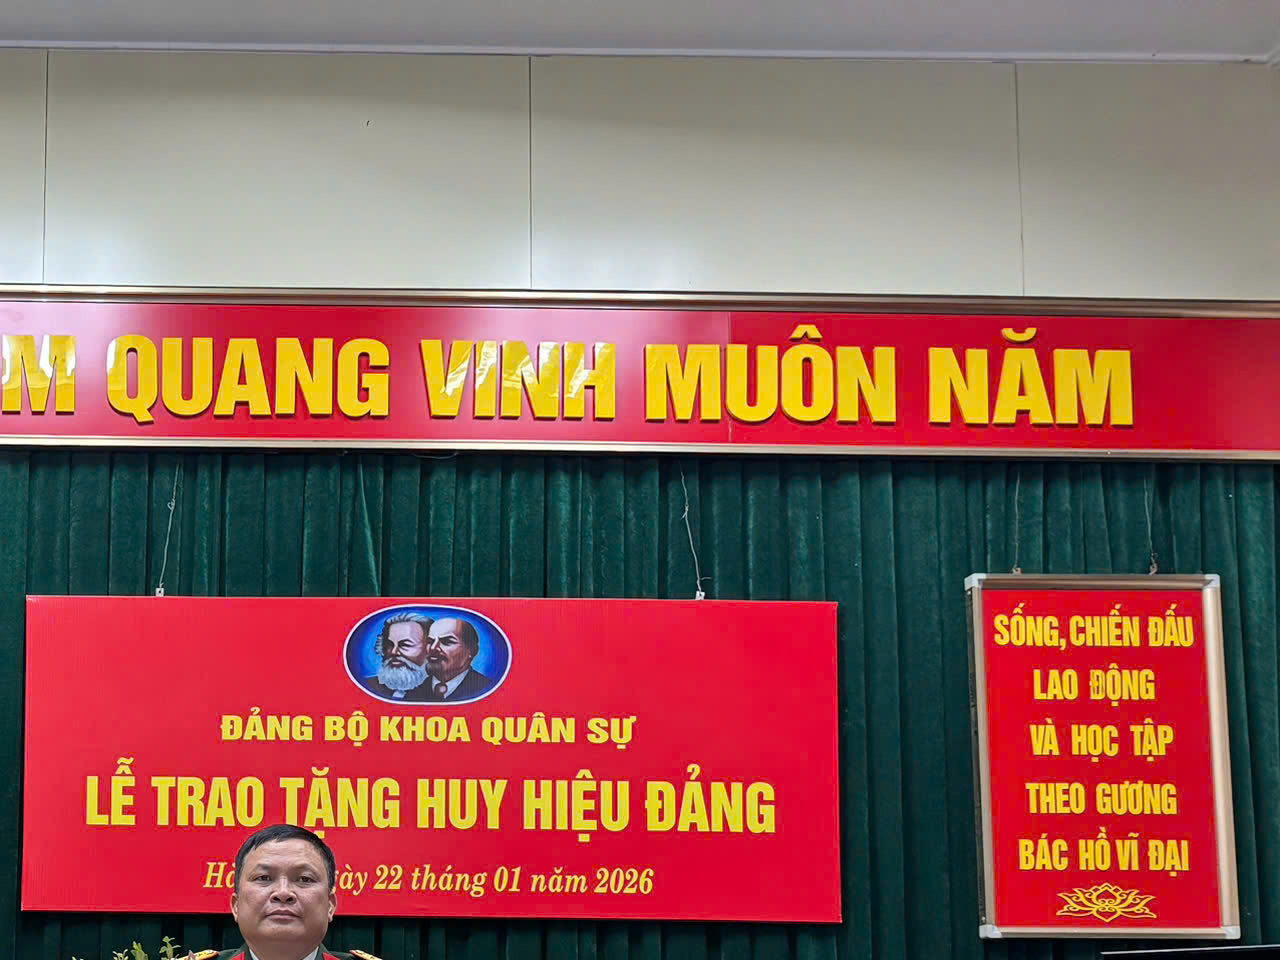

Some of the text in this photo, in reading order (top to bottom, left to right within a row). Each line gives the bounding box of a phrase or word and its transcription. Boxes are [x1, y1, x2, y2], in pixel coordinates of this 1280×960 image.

[106, 333, 391, 423] QUANG
[420, 339, 618, 419] VINH
[645, 324, 897, 424] MUÔN
[927, 326, 1134, 428] NĂM
[992, 602, 1195, 651] SỐNG, CHIẾN ĐẤU
[1033, 662, 1157, 707] LAO ĐỘNG
[220, 707, 638, 750] ĐẢNG BỘ KHOA QUÂN SỰ
[1029, 717, 1175, 763] VÀ HỌC TẬP
[85, 756, 777, 844] LỄ TRAO TẶNG HUY HIỆU ĐẢNG
[1025, 780, 1178, 816] THEO GƯƠNG
[1018, 826, 1191, 878] BÁC HỒ VĨ ĐẠI
[373, 864, 404, 891] 22
[411, 863, 490, 898] tháng
[493, 867, 522, 893] 01
[530, 867, 588, 894] năm
[593, 867, 656, 896] 2026
